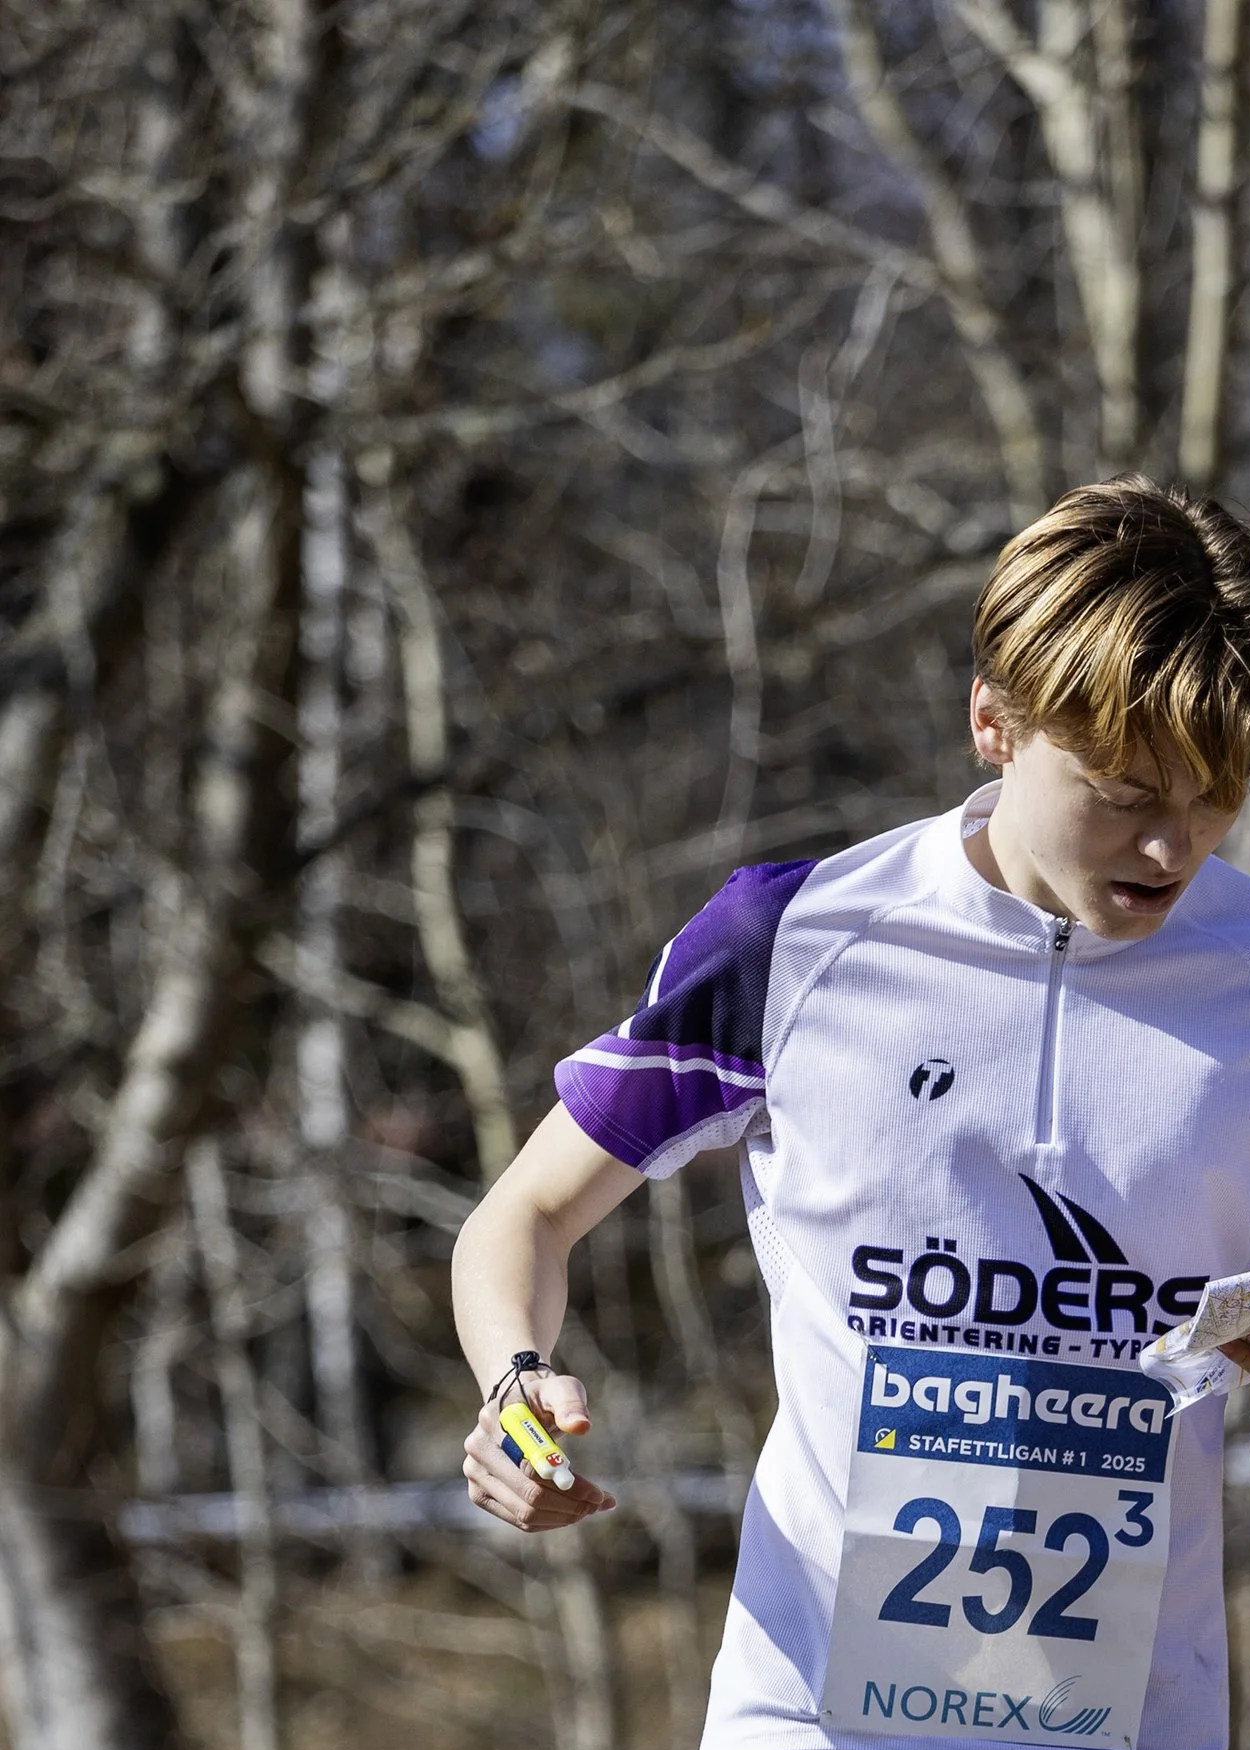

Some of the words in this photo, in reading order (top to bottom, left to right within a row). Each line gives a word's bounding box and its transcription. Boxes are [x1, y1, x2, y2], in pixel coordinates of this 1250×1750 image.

[848, 1236, 1211, 1336] SÖDERS
[846, 1315, 1061, 1357] ORIENTERING
[870, 1363, 1168, 1435] bagheera
[908, 1434, 1057, 1465] STAFETTLIGAN
[1101, 1454, 1146, 1472] 2025
[877, 1497, 1110, 1642] 252
[1114, 1489, 1154, 1547] 3
[862, 1680, 1033, 1731] NOREX
